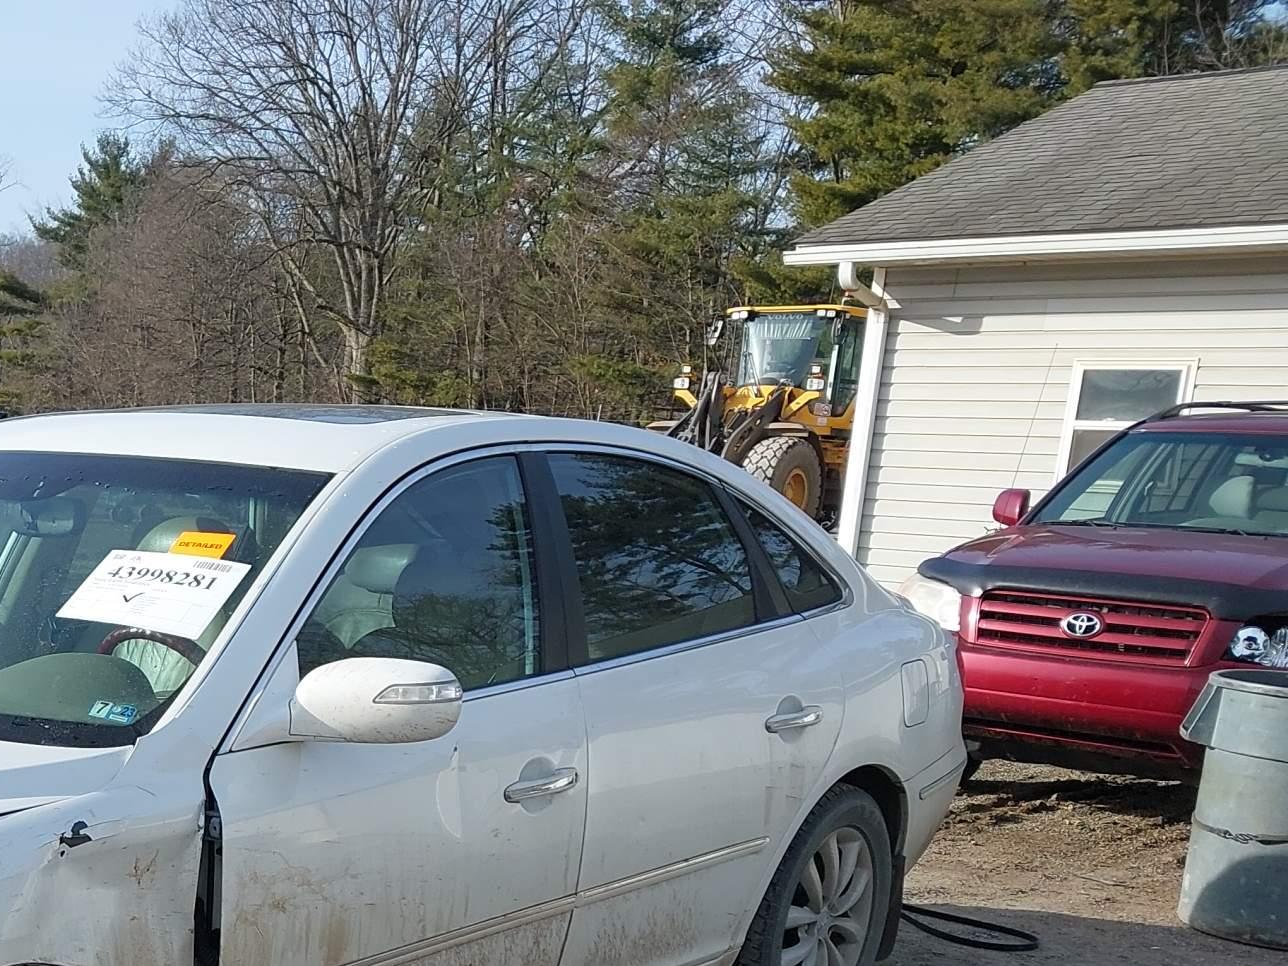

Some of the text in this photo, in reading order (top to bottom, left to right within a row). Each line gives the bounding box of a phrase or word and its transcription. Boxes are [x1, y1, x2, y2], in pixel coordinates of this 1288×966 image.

[178, 540, 224, 550] DETAILED
[107, 564, 219, 590] 43998281
[95, 701, 110, 715] 7
